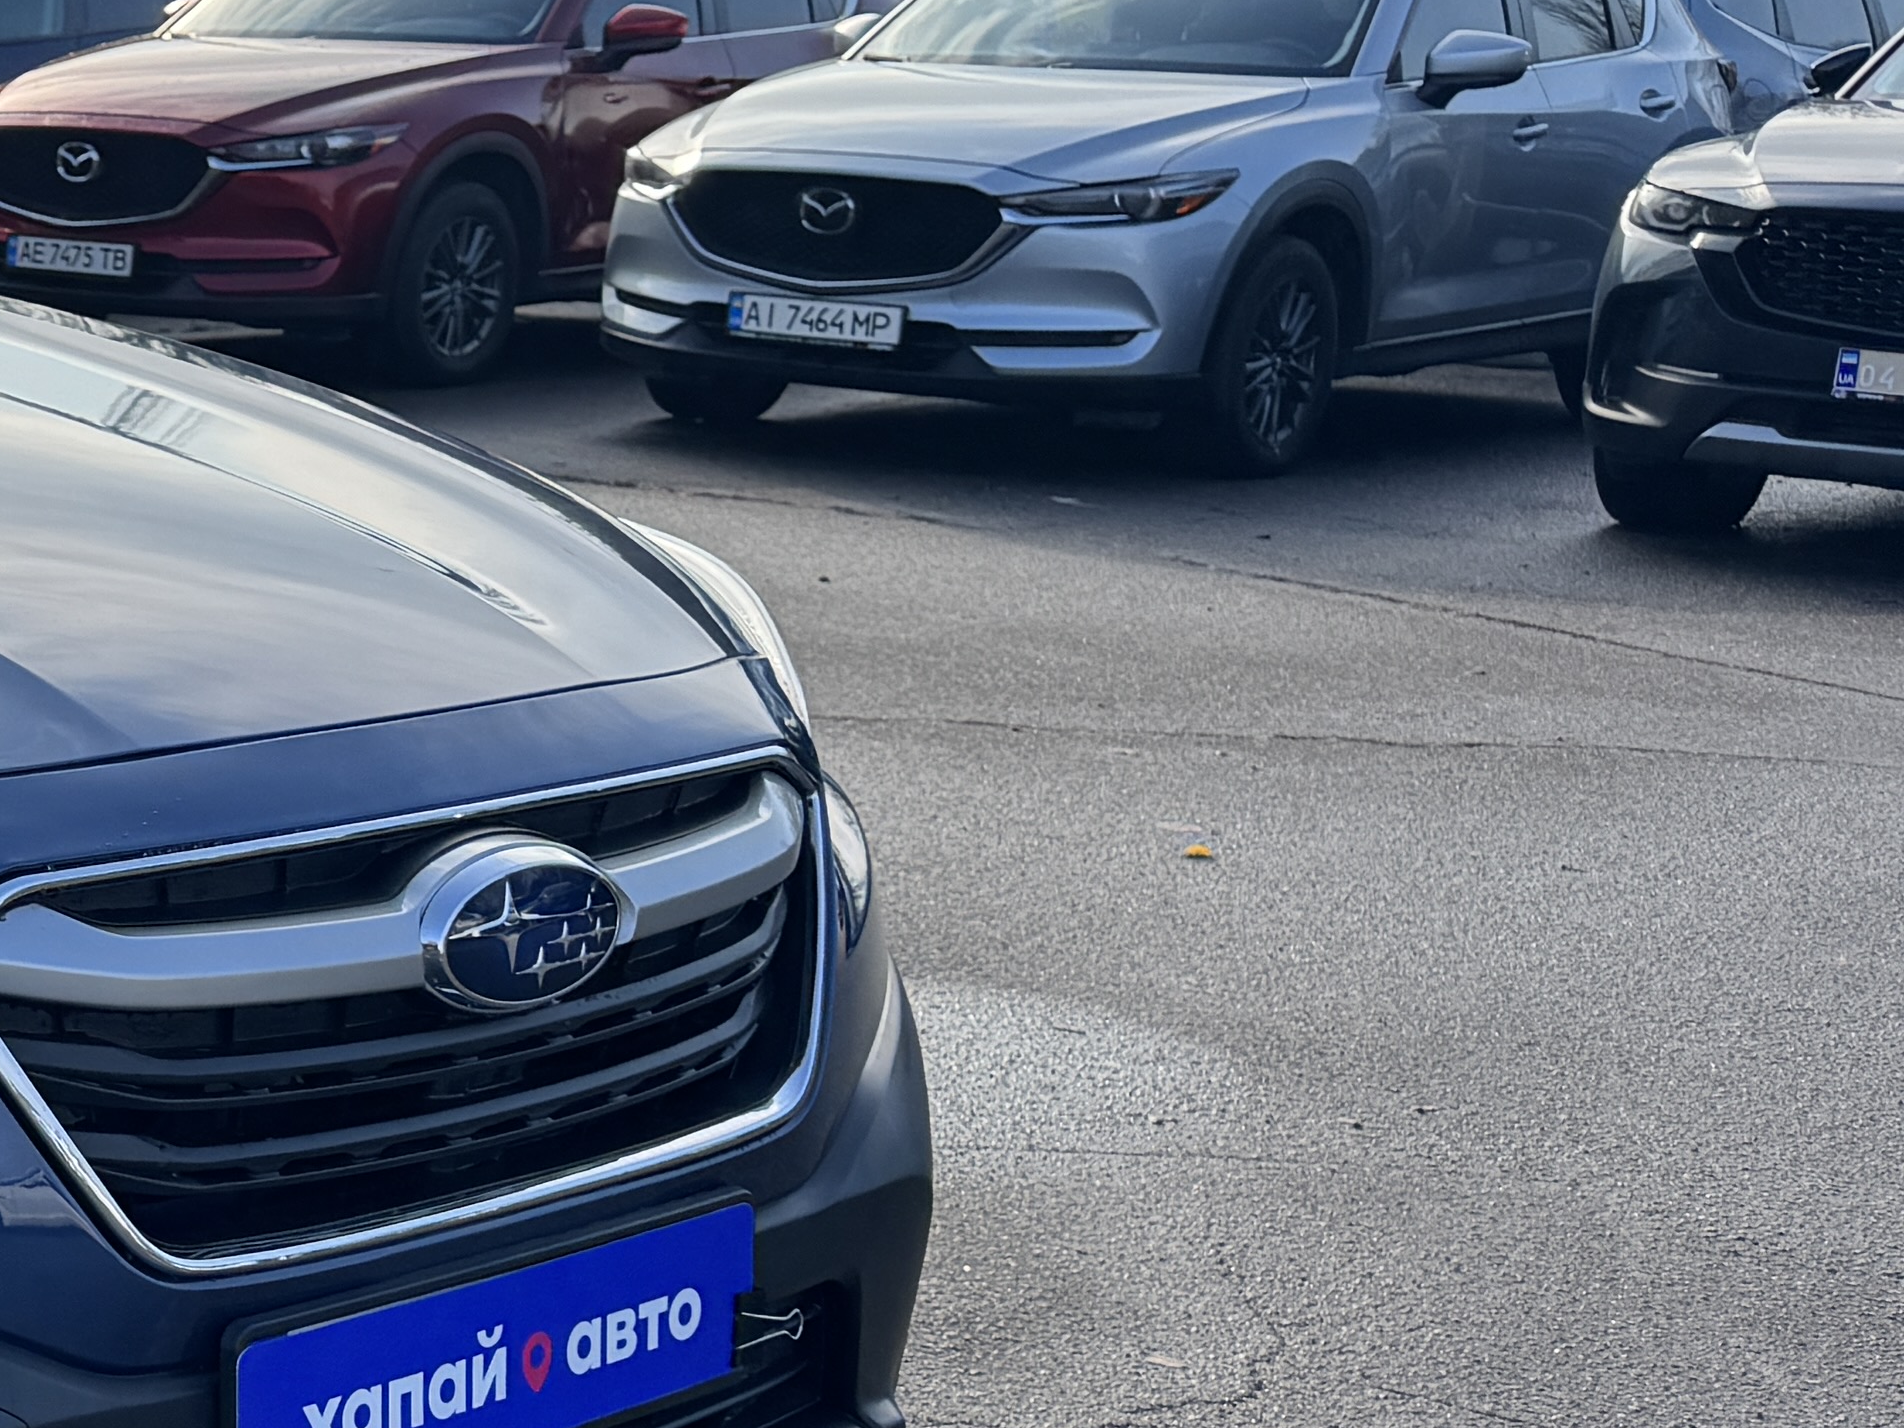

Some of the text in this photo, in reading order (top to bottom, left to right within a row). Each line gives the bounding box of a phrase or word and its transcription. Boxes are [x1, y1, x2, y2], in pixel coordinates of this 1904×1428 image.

[20, 241, 127, 271] AE 7475 TB
[744, 302, 891, 338] AI 7464 MP
[565, 1287, 702, 1375] авто
